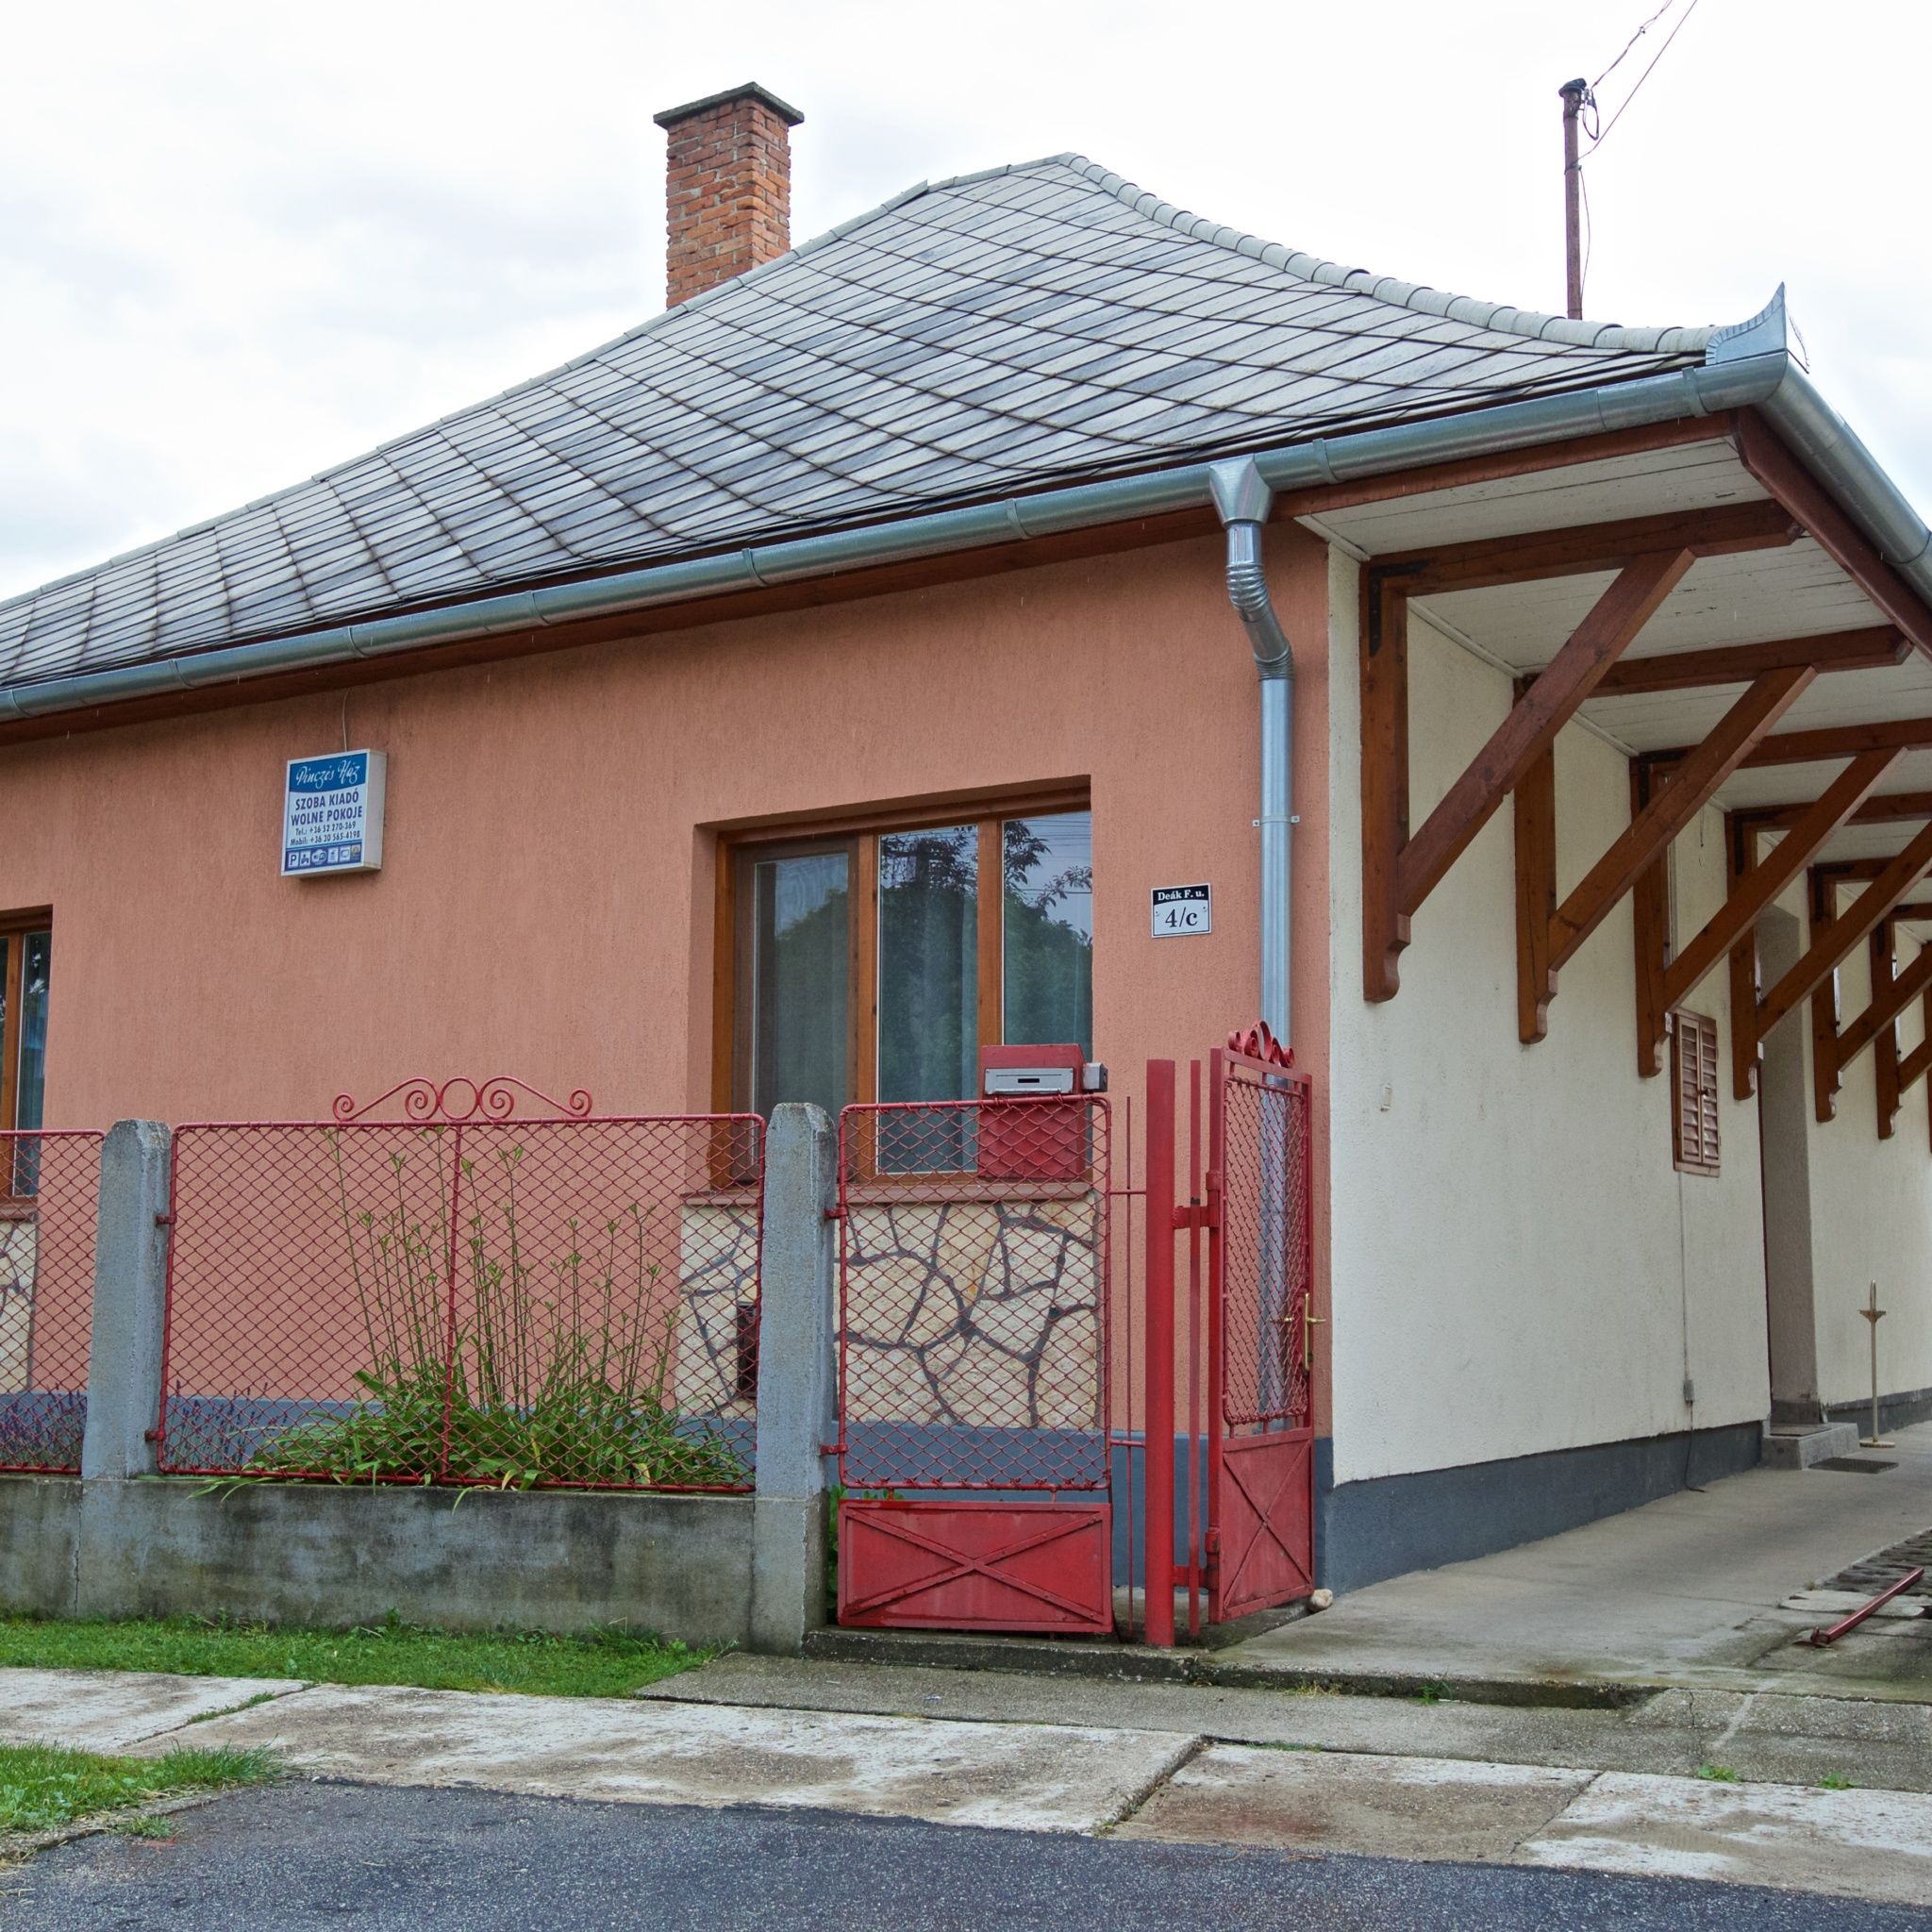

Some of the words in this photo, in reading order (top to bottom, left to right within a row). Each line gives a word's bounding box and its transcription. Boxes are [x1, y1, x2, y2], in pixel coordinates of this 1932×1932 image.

[337, 760, 359, 784] Ház
[295, 795, 325, 811] SZOBA
[329, 788, 358, 806] KIADÓ
[291, 811, 323, 825] WOLNE
[327, 806, 362, 822] POKOJE
[309, 824, 322, 834] +36
[323, 824, 330, 833] 52
[290, 836, 308, 846] Mobil:
[309, 835, 322, 843] +36
[1158, 891, 1182, 901] Deák
[1184, 889, 1193, 898] F.
[1165, 907, 1197, 927] 4/c
